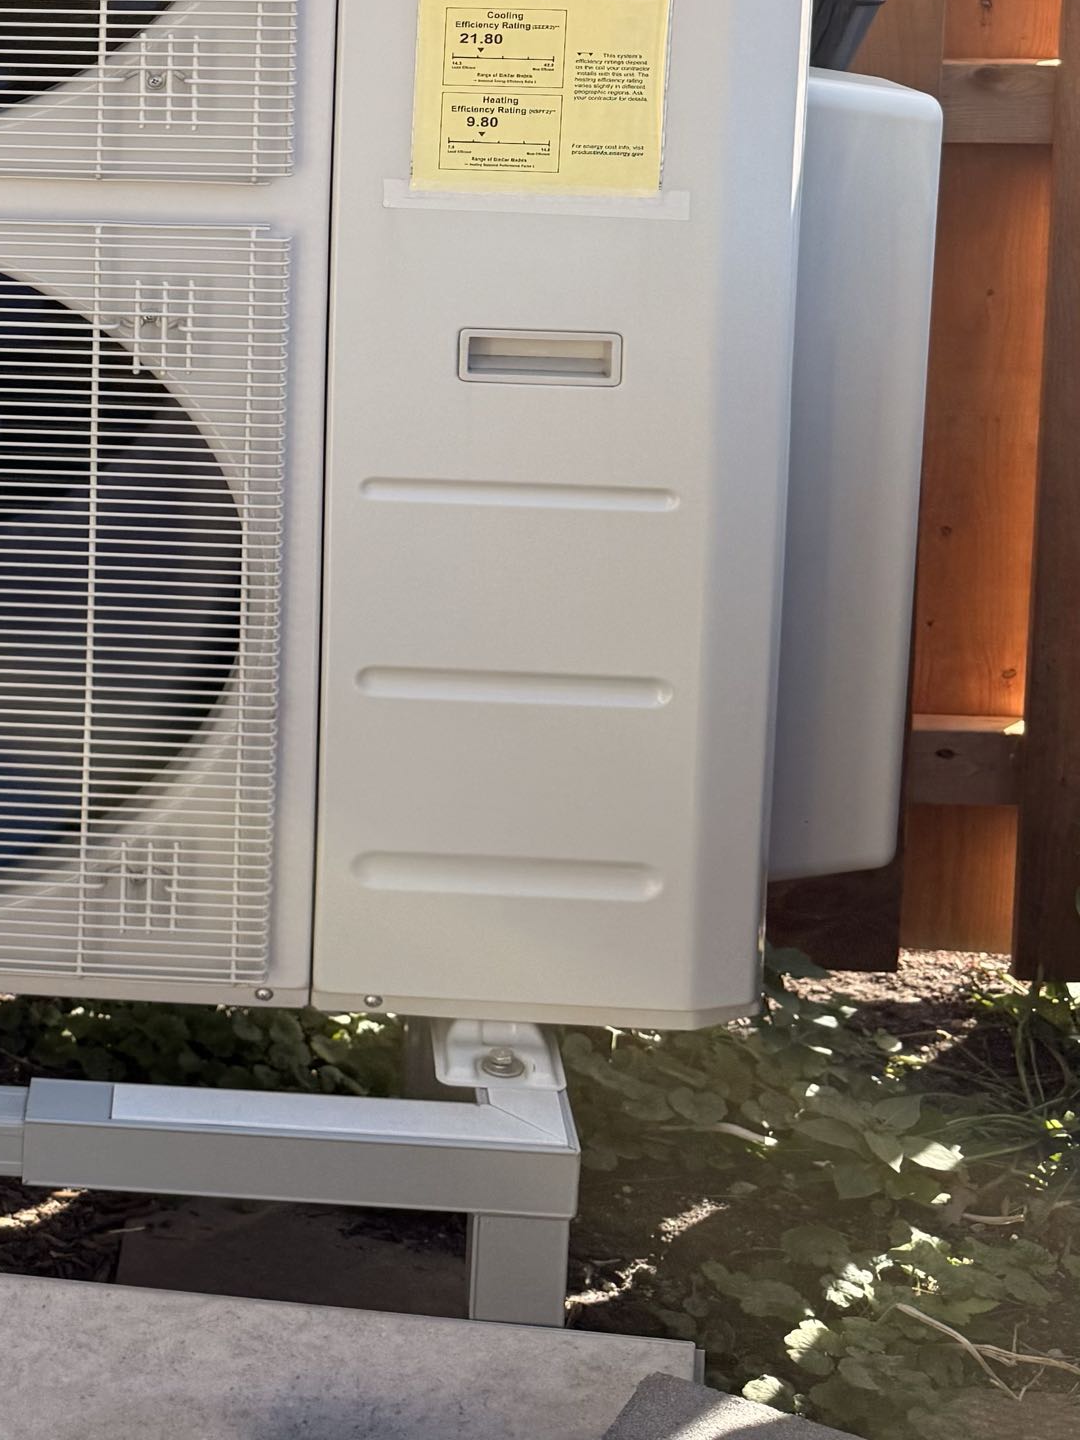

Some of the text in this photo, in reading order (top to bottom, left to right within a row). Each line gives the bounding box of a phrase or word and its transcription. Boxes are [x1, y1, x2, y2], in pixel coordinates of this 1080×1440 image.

[487, 11, 524, 21] Cooling
[455, 20, 500, 30] Efficiency
[502, 21, 531, 31] Rating
[459, 32, 503, 45] 21.80
[482, 95, 519, 106] Heating
[451, 105, 495, 115] Efficiency
[497, 106, 527, 116] Rating
[466, 116, 498, 128] 9.80
